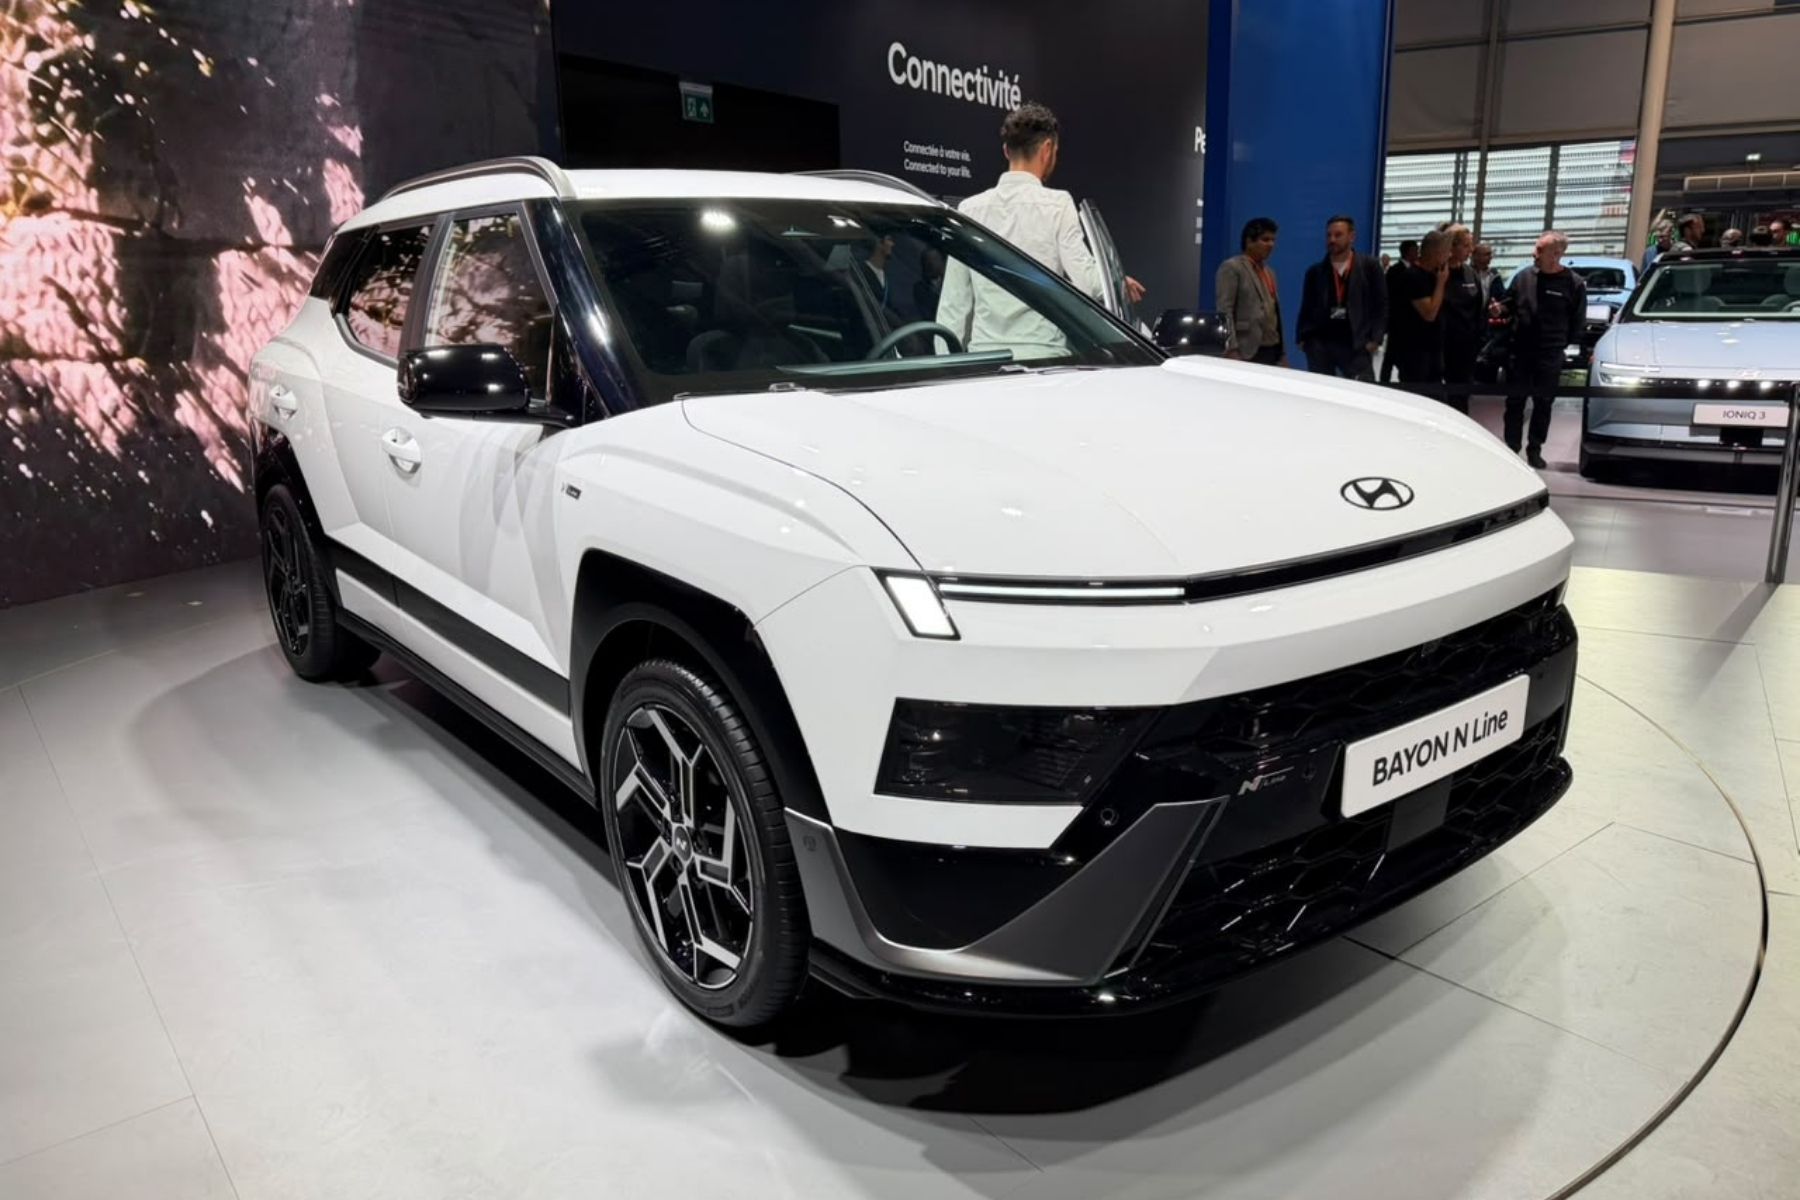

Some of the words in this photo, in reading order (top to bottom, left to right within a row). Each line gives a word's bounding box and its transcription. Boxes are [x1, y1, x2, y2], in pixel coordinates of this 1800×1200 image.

[888, 42, 1021, 111] Connectivité
[903, 140, 939, 157] Connectée
[945, 149, 960, 161] votre
[903, 158, 940, 174] Connected
[940, 163, 947, 175] to
[947, 166, 960, 178] your
[1723, 410, 1757, 420] IONIQ
[1759, 411, 1766, 420] 3
[1372, 730, 1449, 786] BAYON
[1453, 722, 1469, 753] N
[1472, 709, 1508, 744] Line
